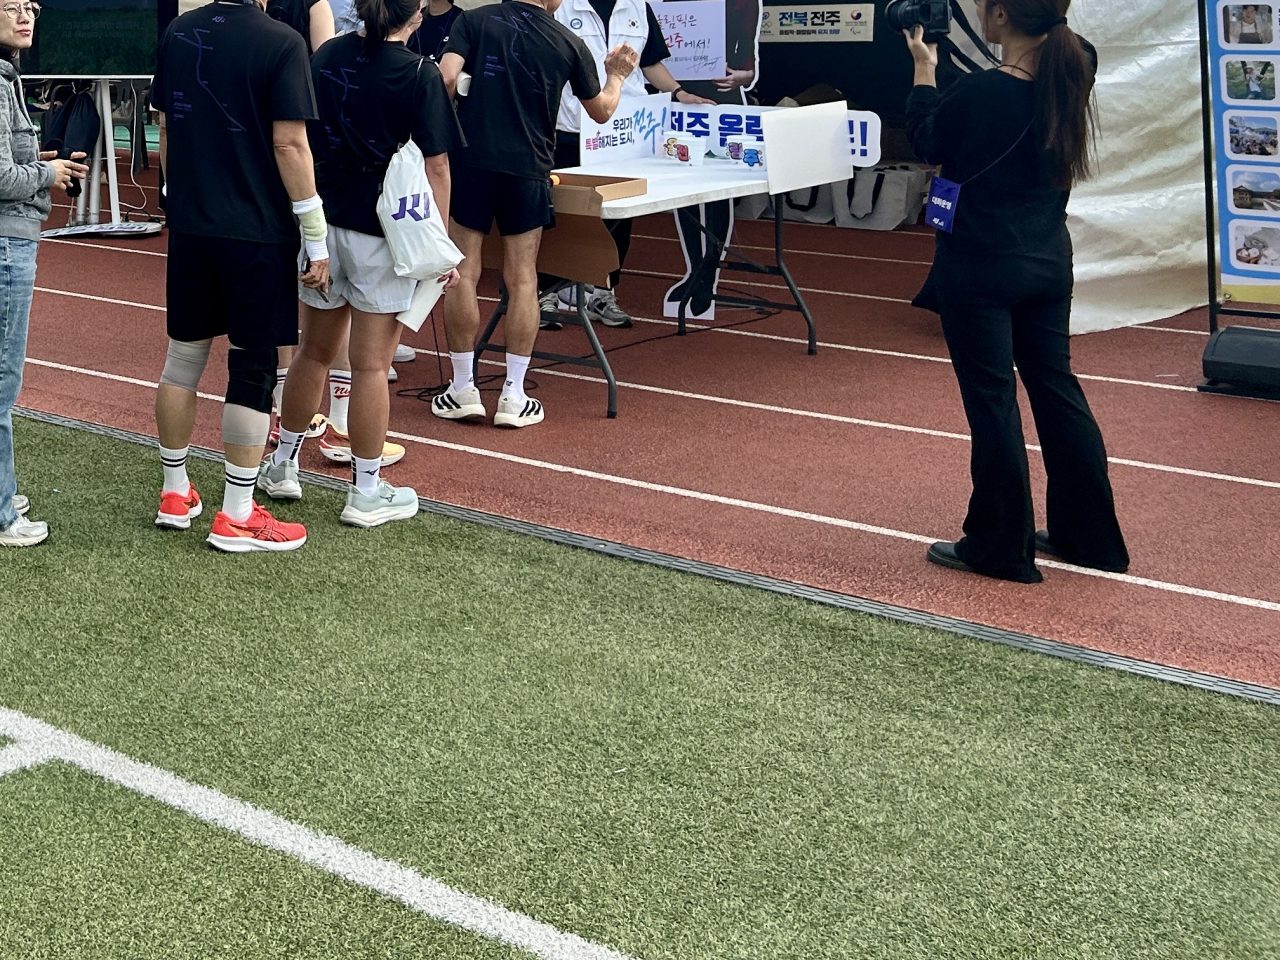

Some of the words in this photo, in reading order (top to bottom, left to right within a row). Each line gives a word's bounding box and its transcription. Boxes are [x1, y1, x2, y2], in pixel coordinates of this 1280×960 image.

[778, 11, 808, 27] 전북
[810, 10, 841, 27] 전주
[613, 117, 633, 132] 우리가
